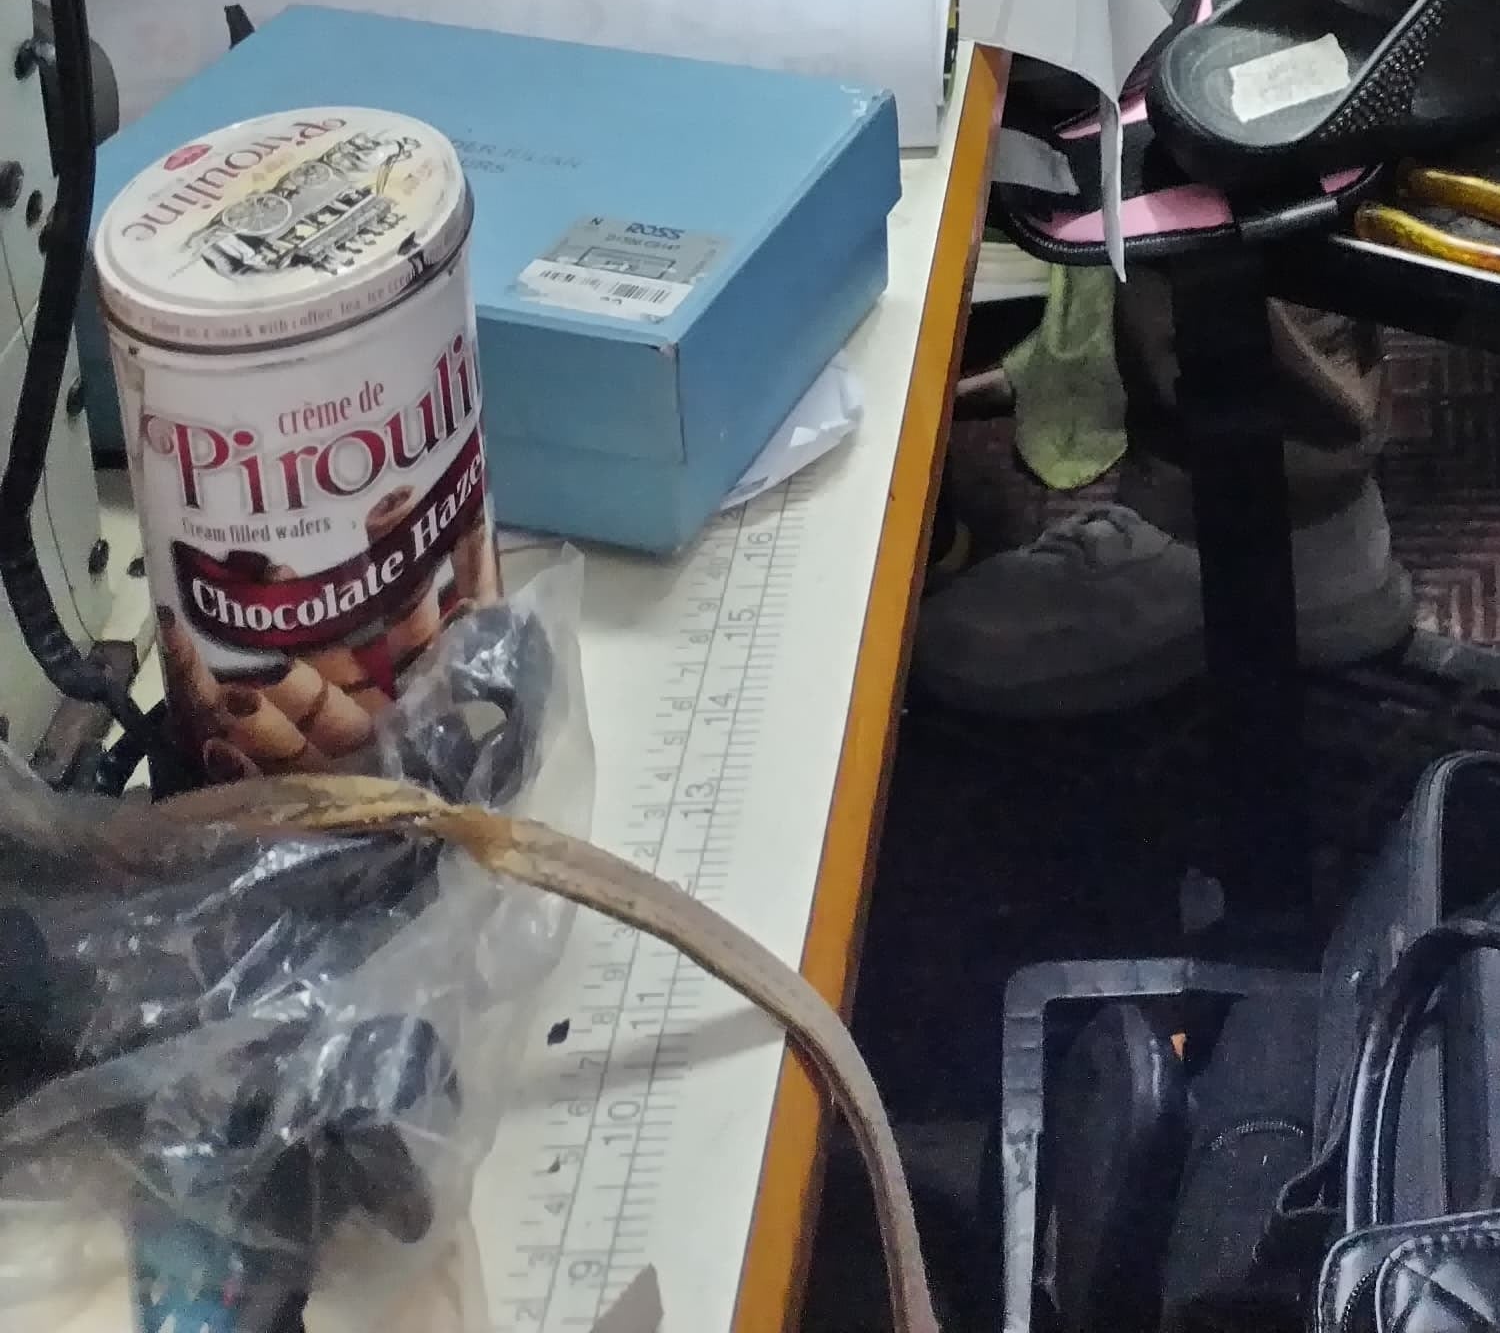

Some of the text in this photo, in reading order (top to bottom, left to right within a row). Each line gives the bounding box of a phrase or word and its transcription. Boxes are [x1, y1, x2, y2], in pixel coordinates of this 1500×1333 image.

[140, 334, 478, 515] Pirouli
[278, 380, 385, 436] crème de
[275, 516, 332, 540] wafers
[191, 549, 406, 632] Chocolate
[600, 1100, 642, 1146] 10
[679, 783, 715, 819] 13
[703, 691, 735, 726] 14
[724, 608, 756, 642] 15
[743, 532, 774, 562] 16
